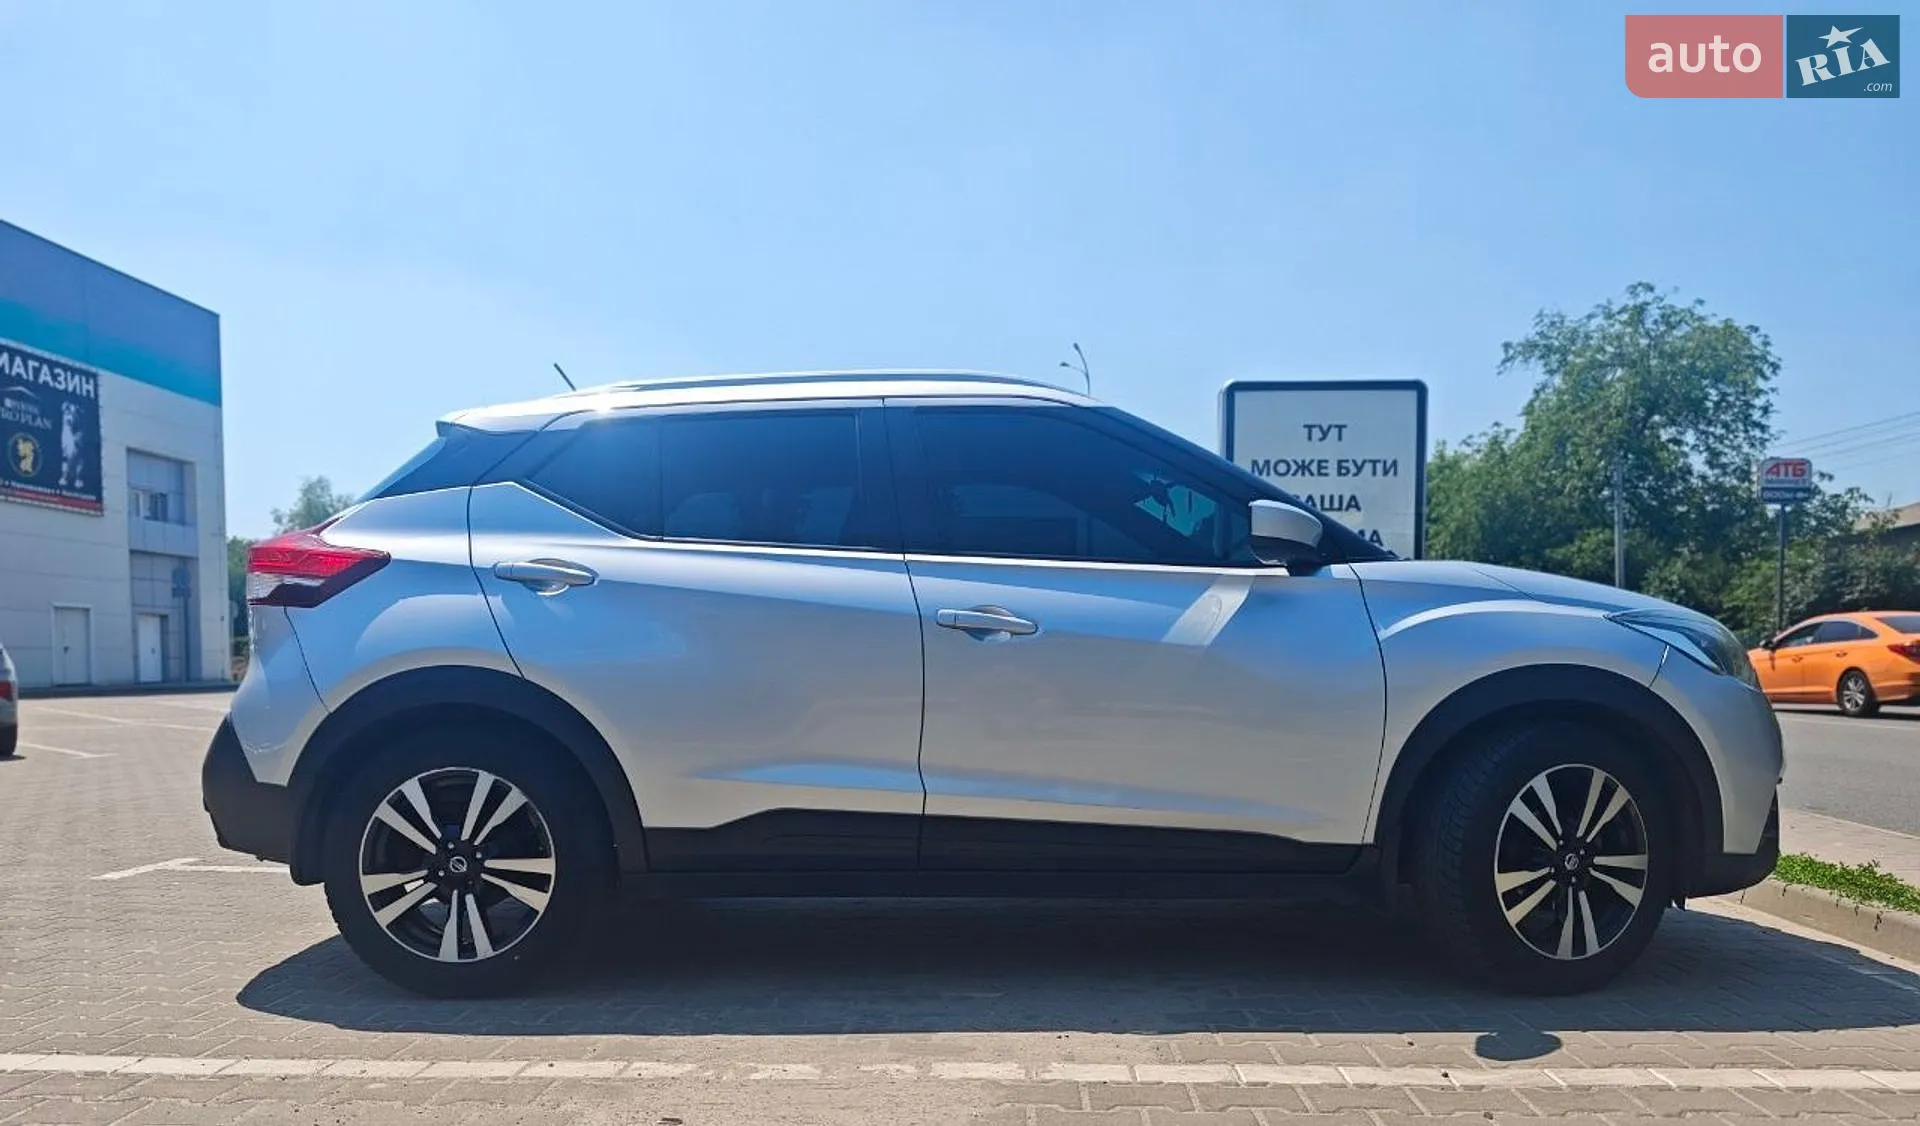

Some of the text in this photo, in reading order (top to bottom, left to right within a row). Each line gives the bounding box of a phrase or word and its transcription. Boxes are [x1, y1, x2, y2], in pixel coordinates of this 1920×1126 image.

[1303, 424, 1347, 442] ТУТ
[1251, 459, 1398, 477] МОЖЕ БУТИ
[1291, 494, 1361, 512] АША
